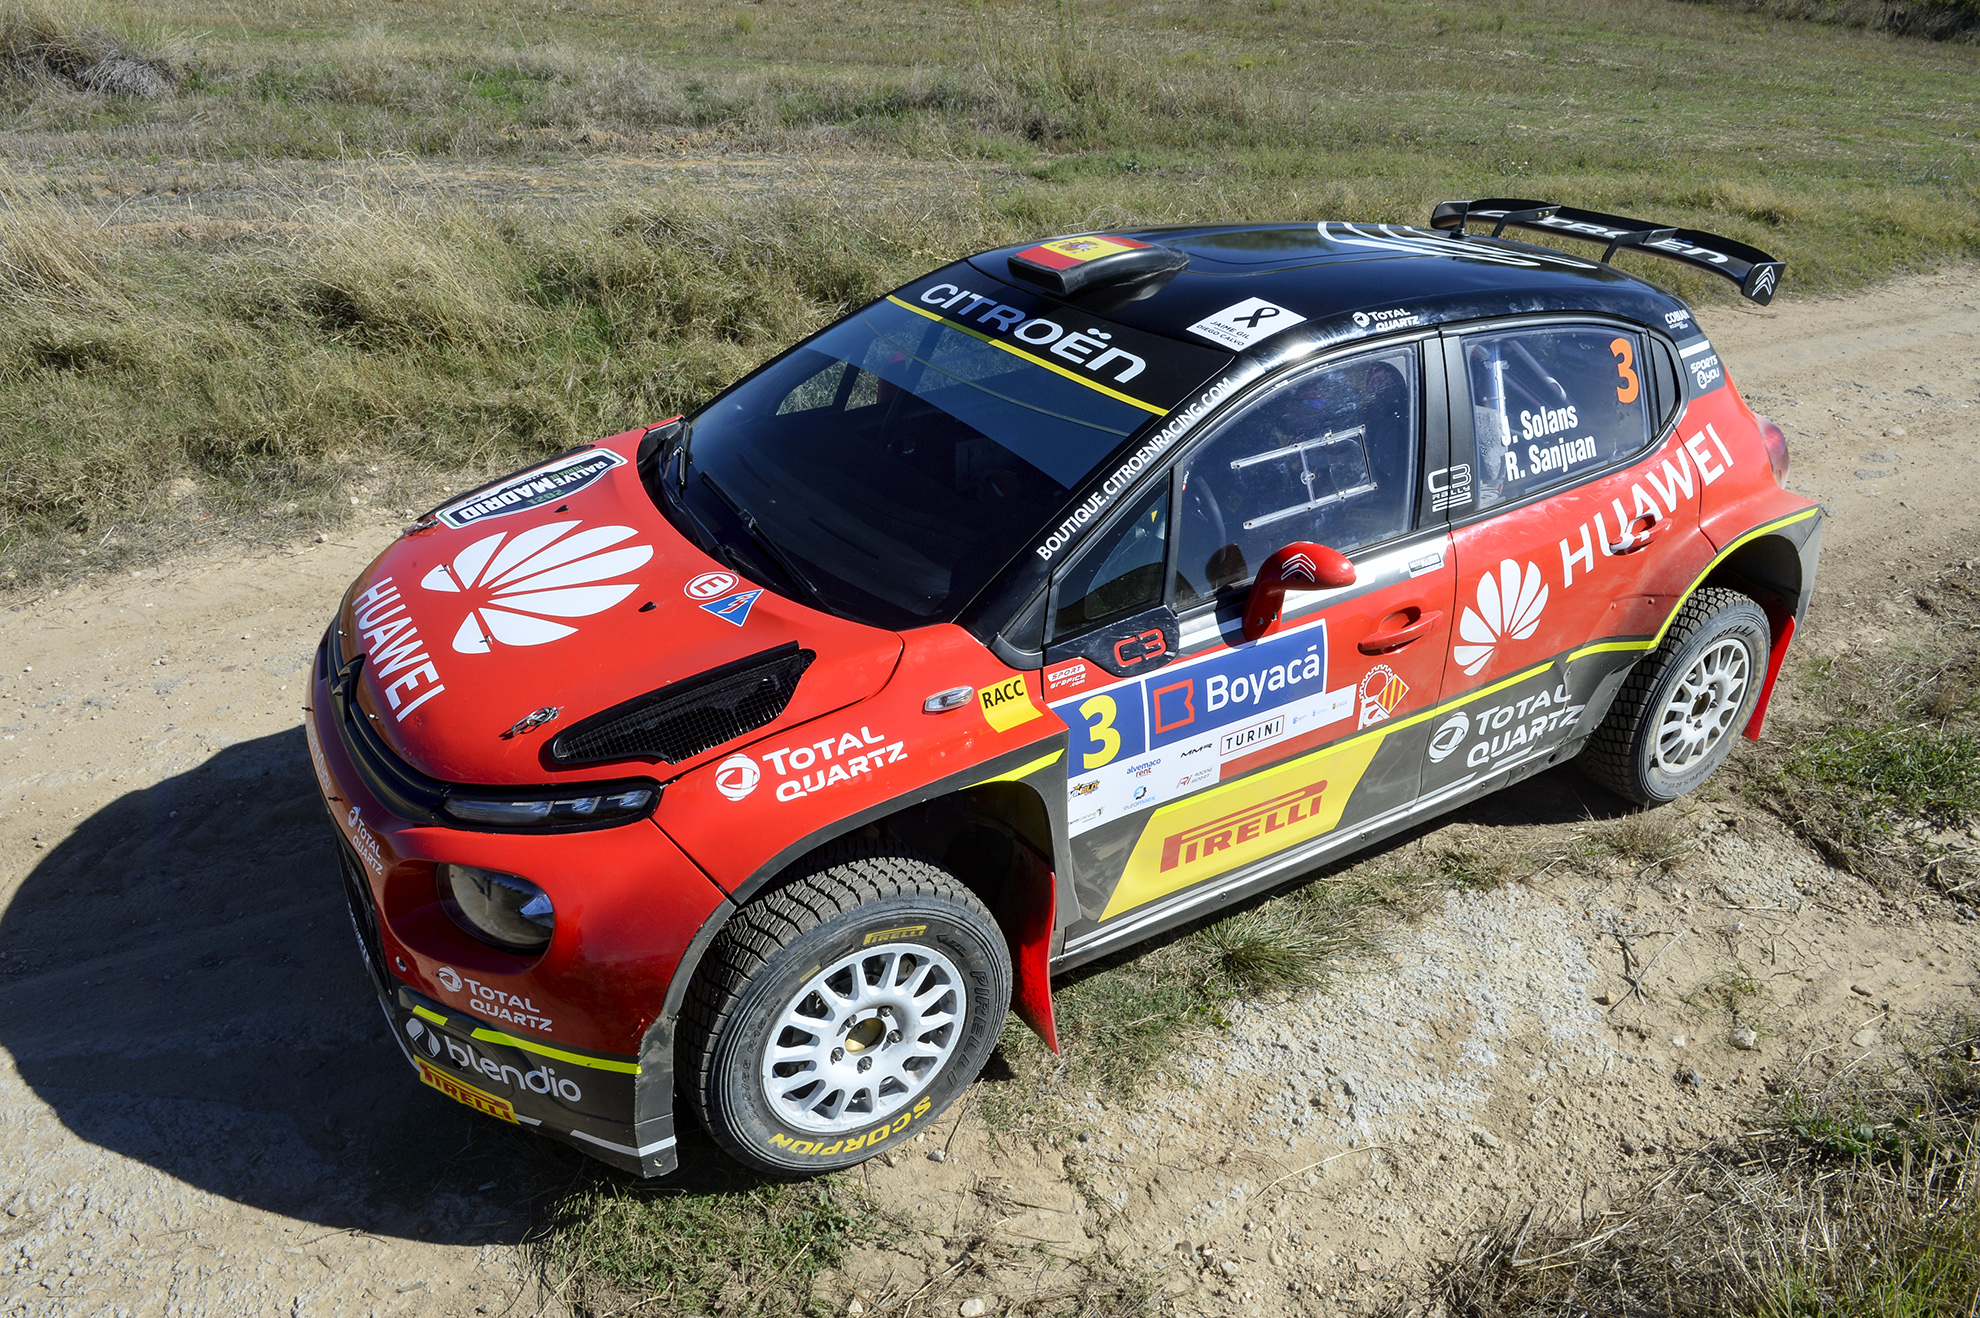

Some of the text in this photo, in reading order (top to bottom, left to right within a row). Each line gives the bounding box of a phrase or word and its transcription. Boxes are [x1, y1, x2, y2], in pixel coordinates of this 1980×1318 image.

[1477, 210, 1729, 264] CTROËN
[920, 283, 1147, 384] CITROËN
[1210, 320, 1251, 340] JAIME GIL
[1367, 308, 1411, 321] TOTAL
[1376, 315, 1420, 332] QUARTZ
[1196, 324, 1245, 347] DIEGO CALVO
[1609, 338, 1640, 404] 3
[1690, 355, 1719, 374] SPORTS
[1501, 405, 1579, 446] J. Solans
[553, 461, 608, 486] RALLYE
[1036, 377, 1232, 561] BOUTIQUE.CITROENRACING.COM
[1428, 463, 1472, 493] C3
[1505, 435, 1597, 482] R. Sanjuan
[458, 476, 557, 520] MADRID
[1559, 422, 1734, 589] HUAWEI
[693, 575, 729, 595] E
[351, 577, 446, 723] HUAWEI
[1113, 628, 1167, 667] C3
[1051, 666, 1082, 680] SPORT
[1728, 640, 1764, 745] SCORPION
[982, 679, 1025, 710] RACC
[1475, 684, 1572, 735] TOTAL
[762, 726, 885, 776] TOTAL
[1078, 694, 1122, 770] 3
[1226, 720, 1280, 750] TURINI
[1467, 704, 1586, 768] QUARTZ
[775, 741, 908, 802] QUARTZ
[1126, 758, 1161, 775] alvemaco
[1135, 767, 1152, 778] rent
[357, 818, 381, 859] TOTAL
[1159, 779, 1328, 874] PIRELLI
[352, 835, 384, 876] QUARTZ
[863, 925, 927, 946] PIRELLI
[464, 978, 540, 1013] TOTAL
[470, 999, 553, 1032] QUARTZ
[947, 970, 990, 1087] PIRELLI
[443, 1035, 582, 1102] blendio
[419, 1061, 513, 1122] PIRELLI
[767, 1095, 932, 1156] SCORPION
